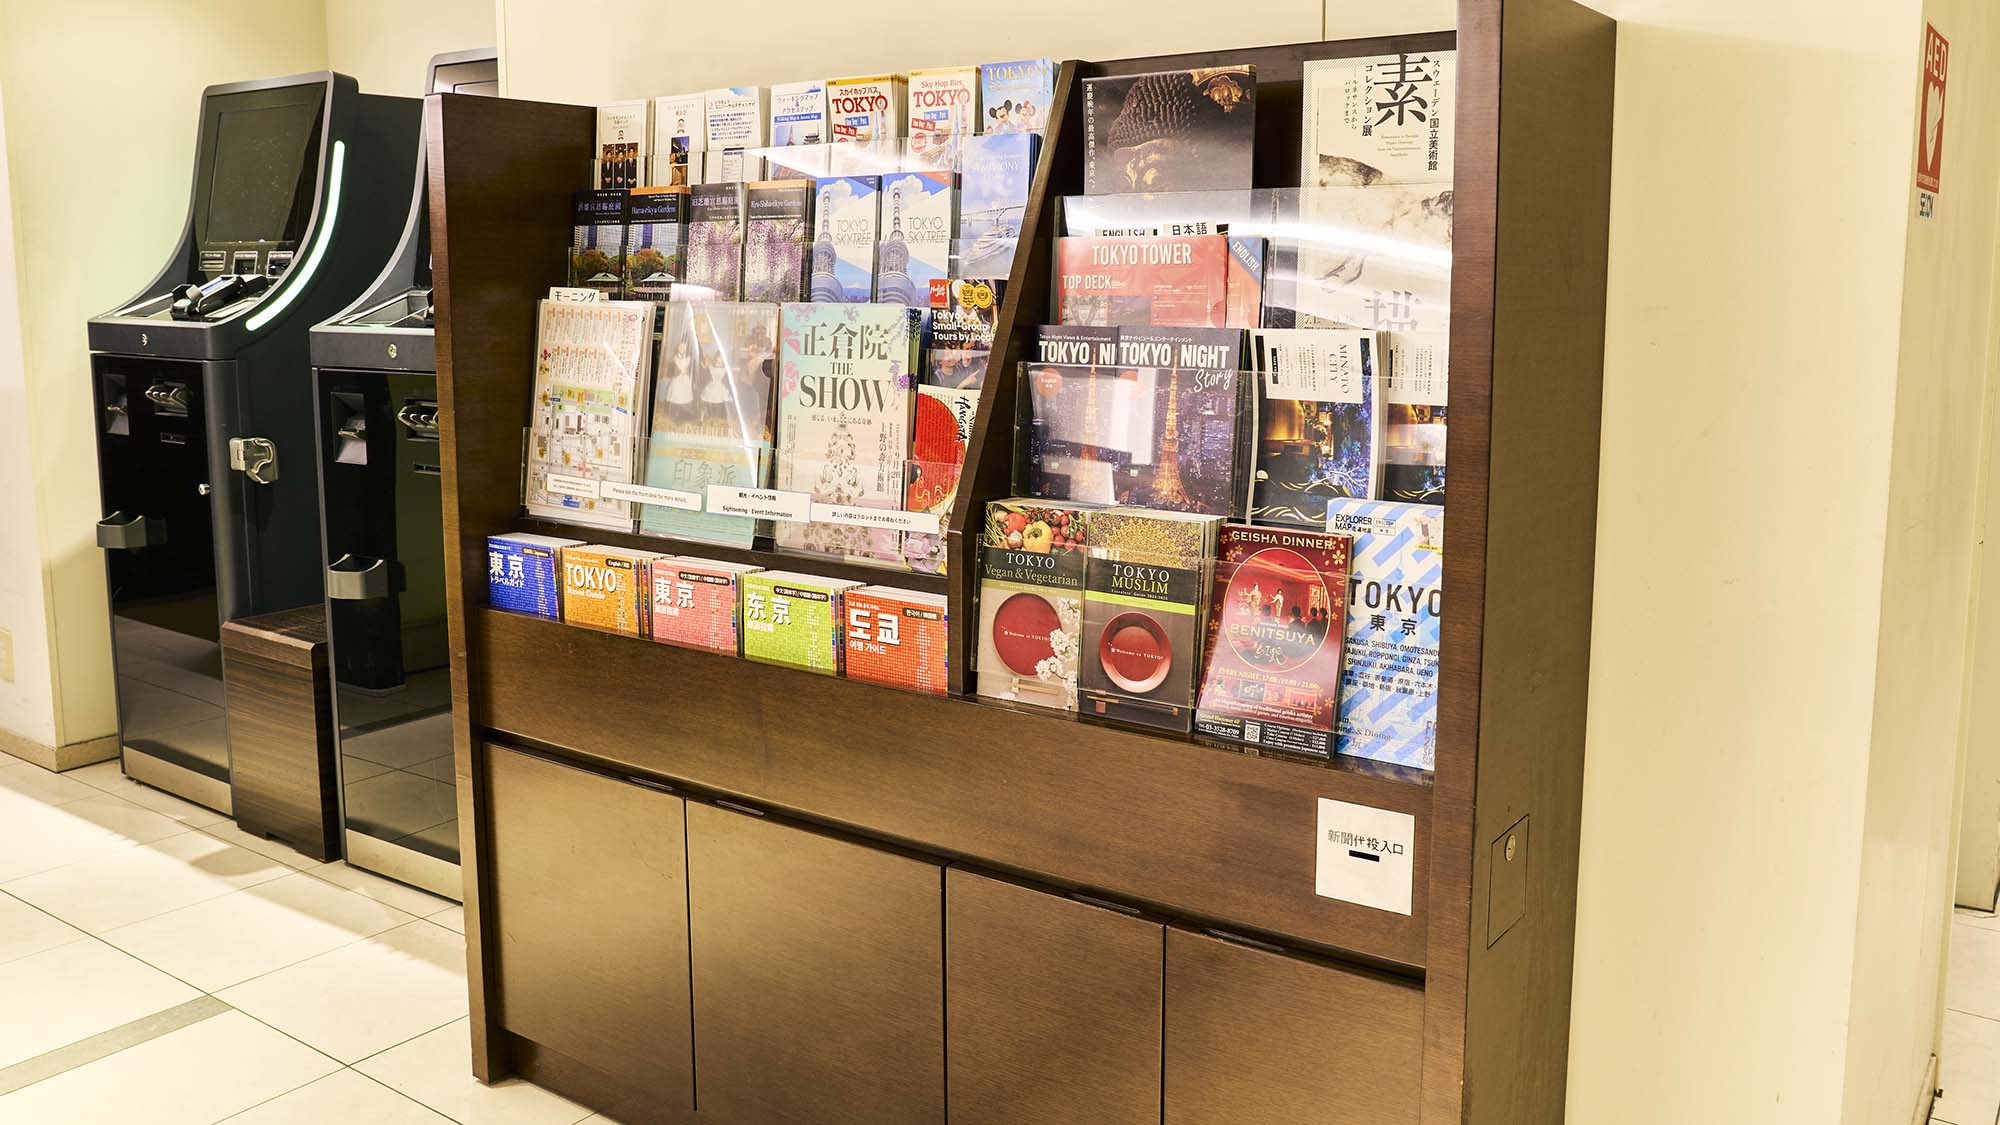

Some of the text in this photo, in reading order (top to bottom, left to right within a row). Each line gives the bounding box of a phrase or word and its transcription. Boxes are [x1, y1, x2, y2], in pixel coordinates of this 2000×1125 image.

[1926, 31, 1947, 82] AED
[985, 64, 1039, 81] TOKYO
[839, 87, 878, 96] スカイホップバス
[921, 81, 932, 89] Sky
[935, 80, 948, 88] Hop
[1373, 53, 1433, 127] 素
[832, 95, 888, 115] TOKYO
[913, 87, 970, 108] TOKYO
[1361, 65, 1374, 137] コレクション展
[1427, 60, 1441, 171] スウェーデン国立美術館
[836, 218, 869, 232] TOKYO
[909, 216, 944, 231] TOKYO
[1172, 222, 1208, 236] 日本語
[907, 231, 947, 244] SKYTREE
[1092, 243, 1192, 265] TOKYO TOWER
[1232, 242, 1259, 272] ENGLISH
[1063, 275, 1112, 289] TOP DECK
[554, 291, 596, 302] モーニング
[932, 310, 961, 322] Tokyo
[932, 322, 988, 334] Small-Group
[933, 332, 958, 341] Tours
[959, 332, 969, 344] by
[800, 322, 889, 360] 正倉院
[1039, 341, 1090, 364] TOKYO
[1120, 342, 1230, 368] TOKYO NIGHT
[830, 362, 854, 376] THE
[1328, 353, 1339, 384] CITY
[1339, 344, 1350, 394] MINATO
[1194, 368, 1233, 393] Story
[800, 374, 891, 413] SHOW
[672, 460, 737, 488] 印象派
[722, 506, 793, 518] Sightseeing Event Information
[1335, 514, 1372, 526] EXPLORER
[1334, 522, 1352, 530] MAP
[1232, 530, 1333, 550] GEISHA DINNER
[488, 550, 525, 579] 東京
[1006, 552, 1056, 569] TOKYO
[490, 576, 525, 588] トラベルガイド
[565, 562, 616, 593] TOKYO
[985, 564, 1078, 586] Vegan & Vegetarian
[1112, 564, 1170, 582] TOKYO
[568, 588, 606, 600] Travel Guide
[654, 577, 695, 608] 東京
[1112, 576, 1169, 595] MUSLIM
[1349, 578, 1440, 618] TOKYO
[746, 592, 792, 625] 东京
[848, 608, 900, 646] 도쿄
[1230, 623, 1316, 646] BENITSUYA
[1370, 614, 1418, 636] 東京
[849, 640, 886, 654] 여행 가이드
[1417, 668, 1434, 678] UENO
[1327, 829, 1404, 856] 新聞代投入口
